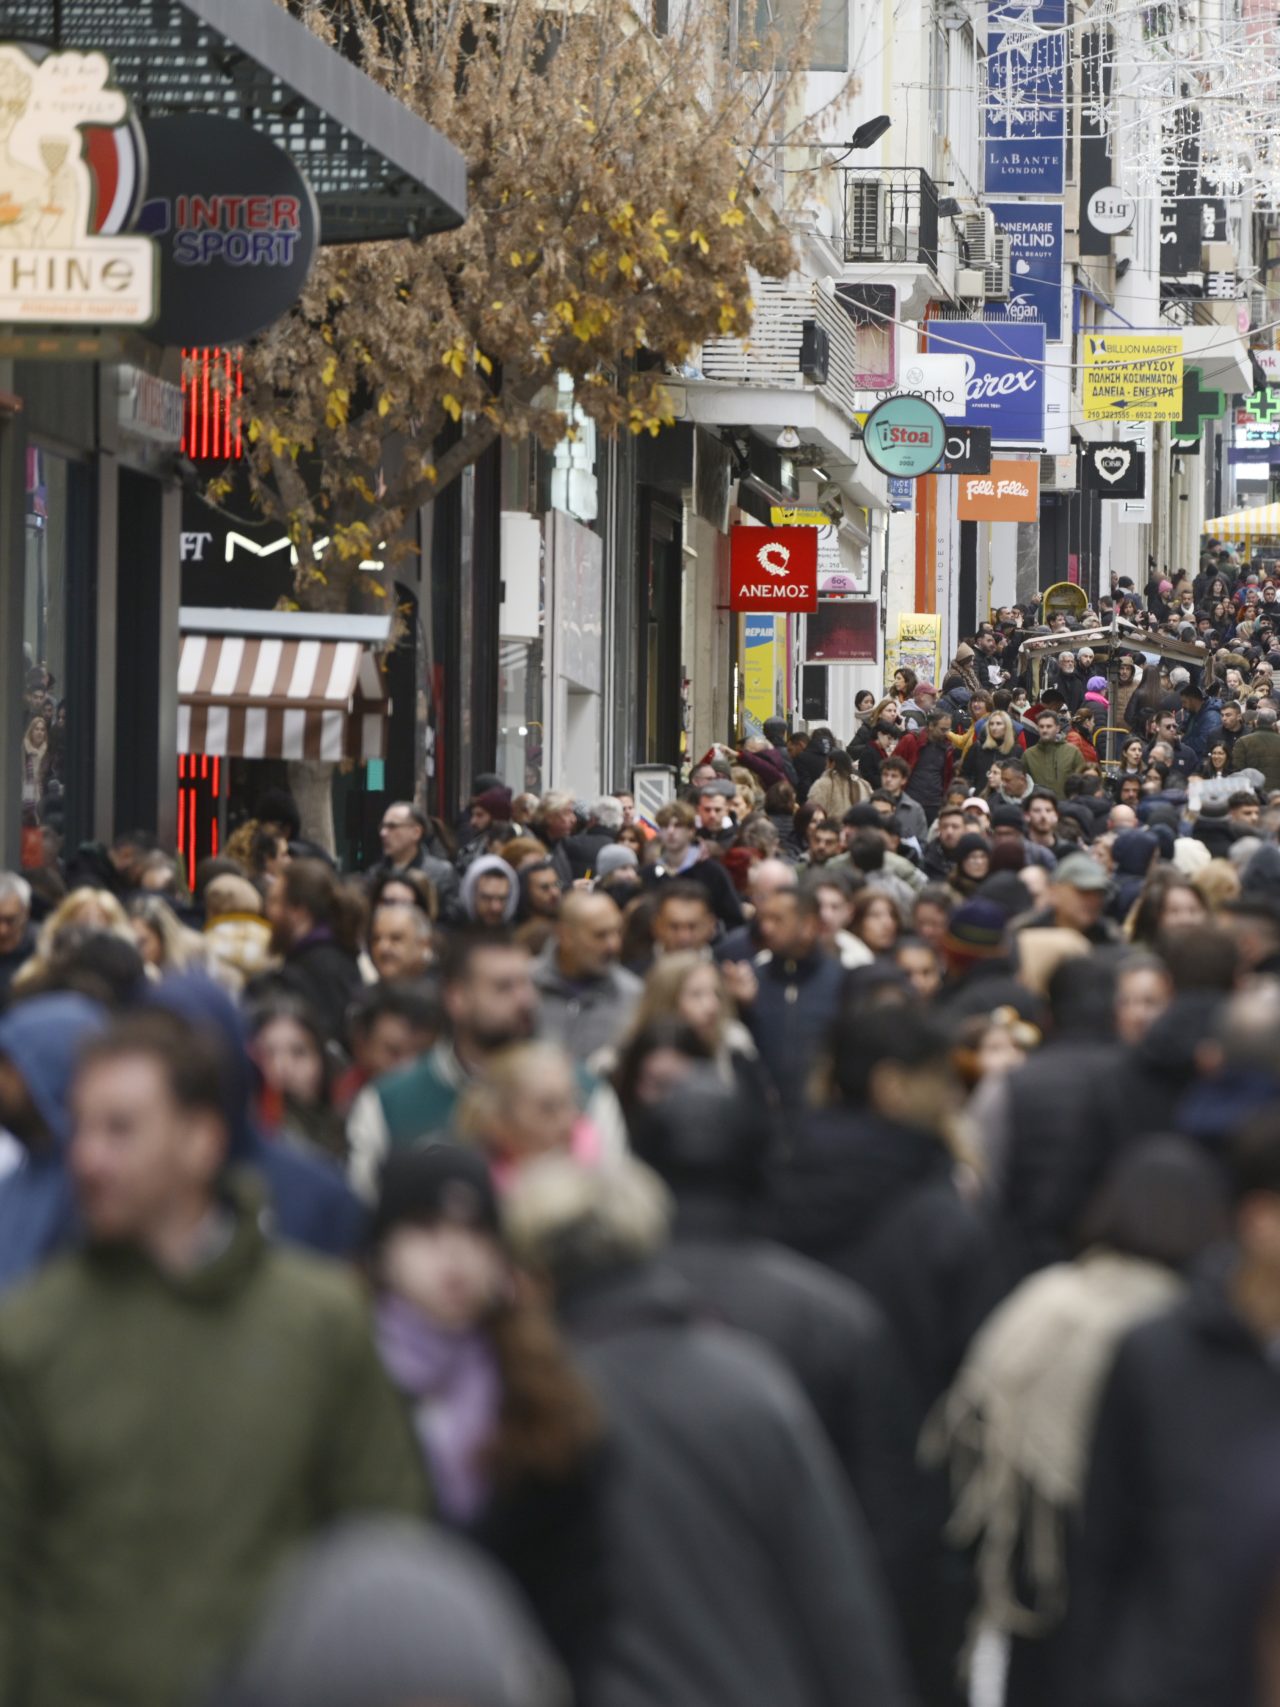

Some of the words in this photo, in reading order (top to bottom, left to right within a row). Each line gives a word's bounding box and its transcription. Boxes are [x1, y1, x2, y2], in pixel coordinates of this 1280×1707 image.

[176, 195, 299, 229] INTER
[1095, 200, 1126, 217] Big
[1008, 233, 1055, 247] RLIND
[173, 231, 299, 266] SPORT
[1004, 300, 1038, 320] Vegan
[1107, 345, 1140, 353] BILLION
[1142, 345, 1178, 354] MARKET
[1093, 360, 1128, 371] ΑΓΟΡΑ
[1132, 360, 1175, 371] ΧΡΥΣΟΥ
[1257, 356, 1276, 368] ink
[1088, 373, 1120, 384] ΠΩΛΗΣΗ
[1123, 373, 1178, 384] ΚΟΣΜΗΜΑΤΩΝ
[876, 386, 954, 402] aento
[1092, 386, 1125, 397] ΔΑΝΕΙΑ
[1133, 387, 1174, 397] ΕΝΕΧΥΡΑ
[883, 427, 929, 444] iStoa
[967, 481, 994, 500] Folli
[997, 480, 1029, 498] Follie
[739, 584, 809, 598] ΑΝΕΜΟΣ
[745, 627, 774, 637] REPAIR
